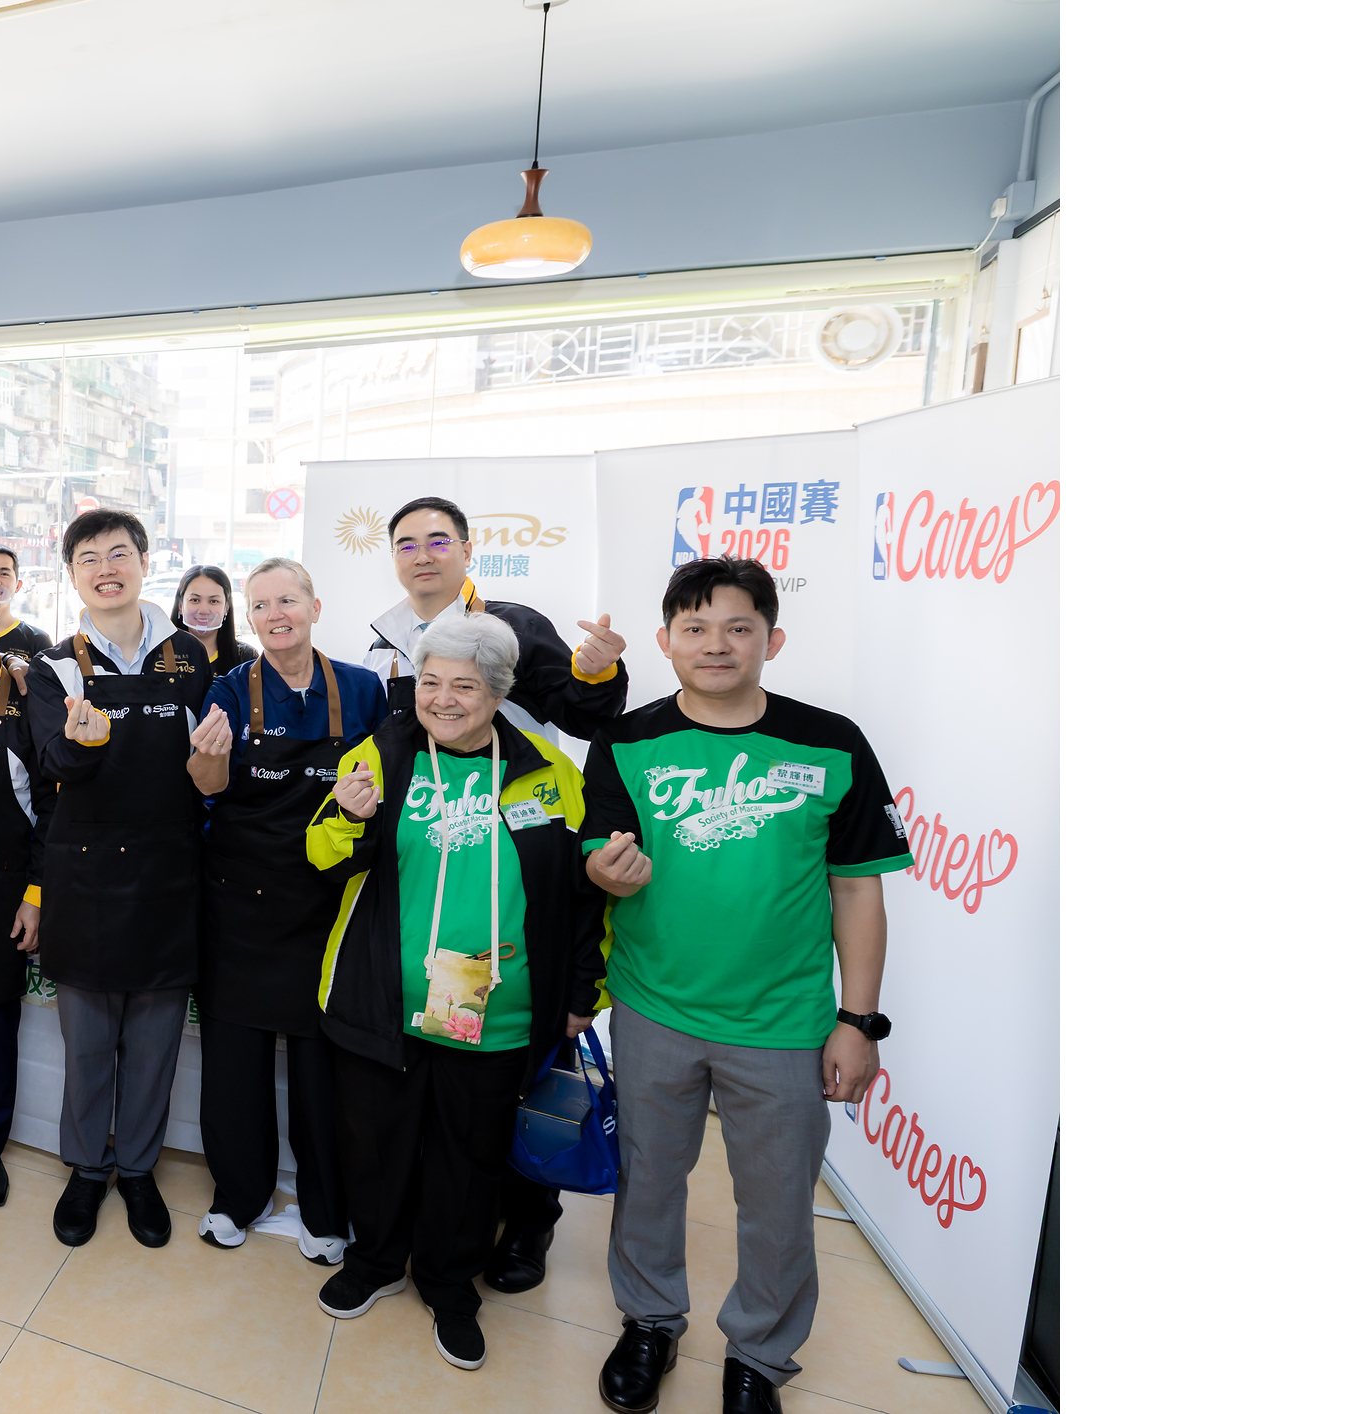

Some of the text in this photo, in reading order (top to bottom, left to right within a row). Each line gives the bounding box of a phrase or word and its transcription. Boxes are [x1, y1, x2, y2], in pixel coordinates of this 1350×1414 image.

[724, 479, 840, 525] 中國賽
[467, 513, 568, 547] ands
[896, 480, 1060, 584] Cares
[721, 528, 791, 571] 2026
[154, 660, 196, 673] Snds
[257, 768, 290, 780] Cares
[698, 804, 763, 828] Society of Macau
[863, 1068, 987, 1229] Cares
